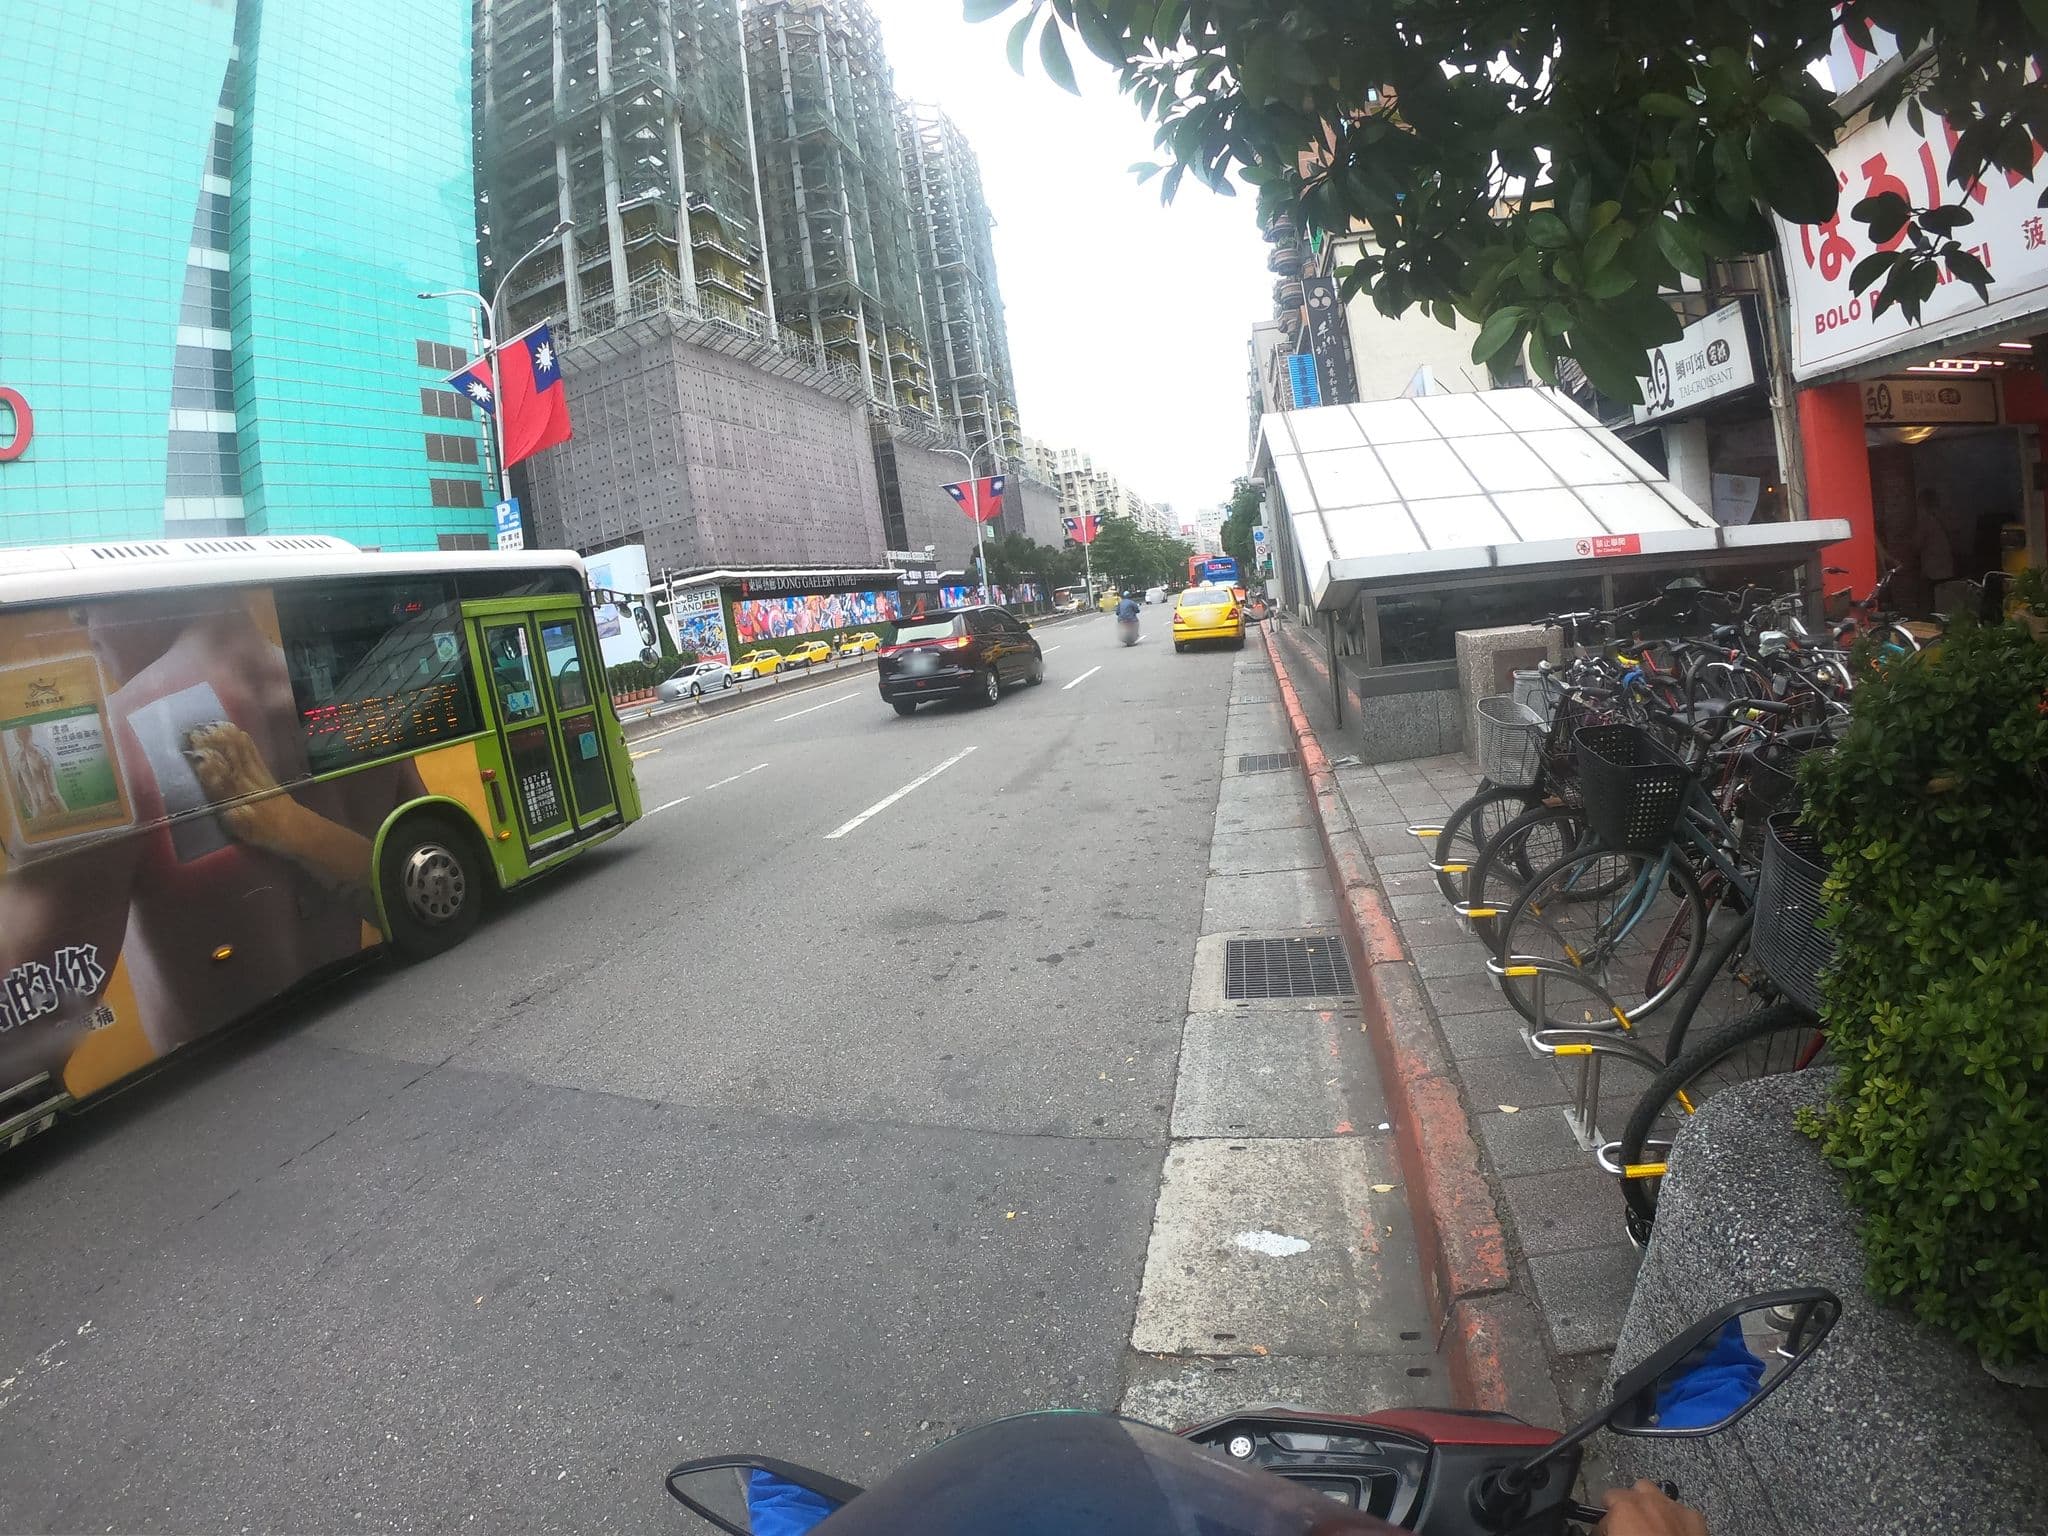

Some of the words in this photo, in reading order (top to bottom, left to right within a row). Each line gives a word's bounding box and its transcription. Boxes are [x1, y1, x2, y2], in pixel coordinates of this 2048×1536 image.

[1814, 299, 1861, 335] BOLO
[497, 503, 511, 524] P
[777, 577, 801, 590] DONG
[836, 575, 857, 586] TAIPEI
[676, 602, 702, 613] LAND
